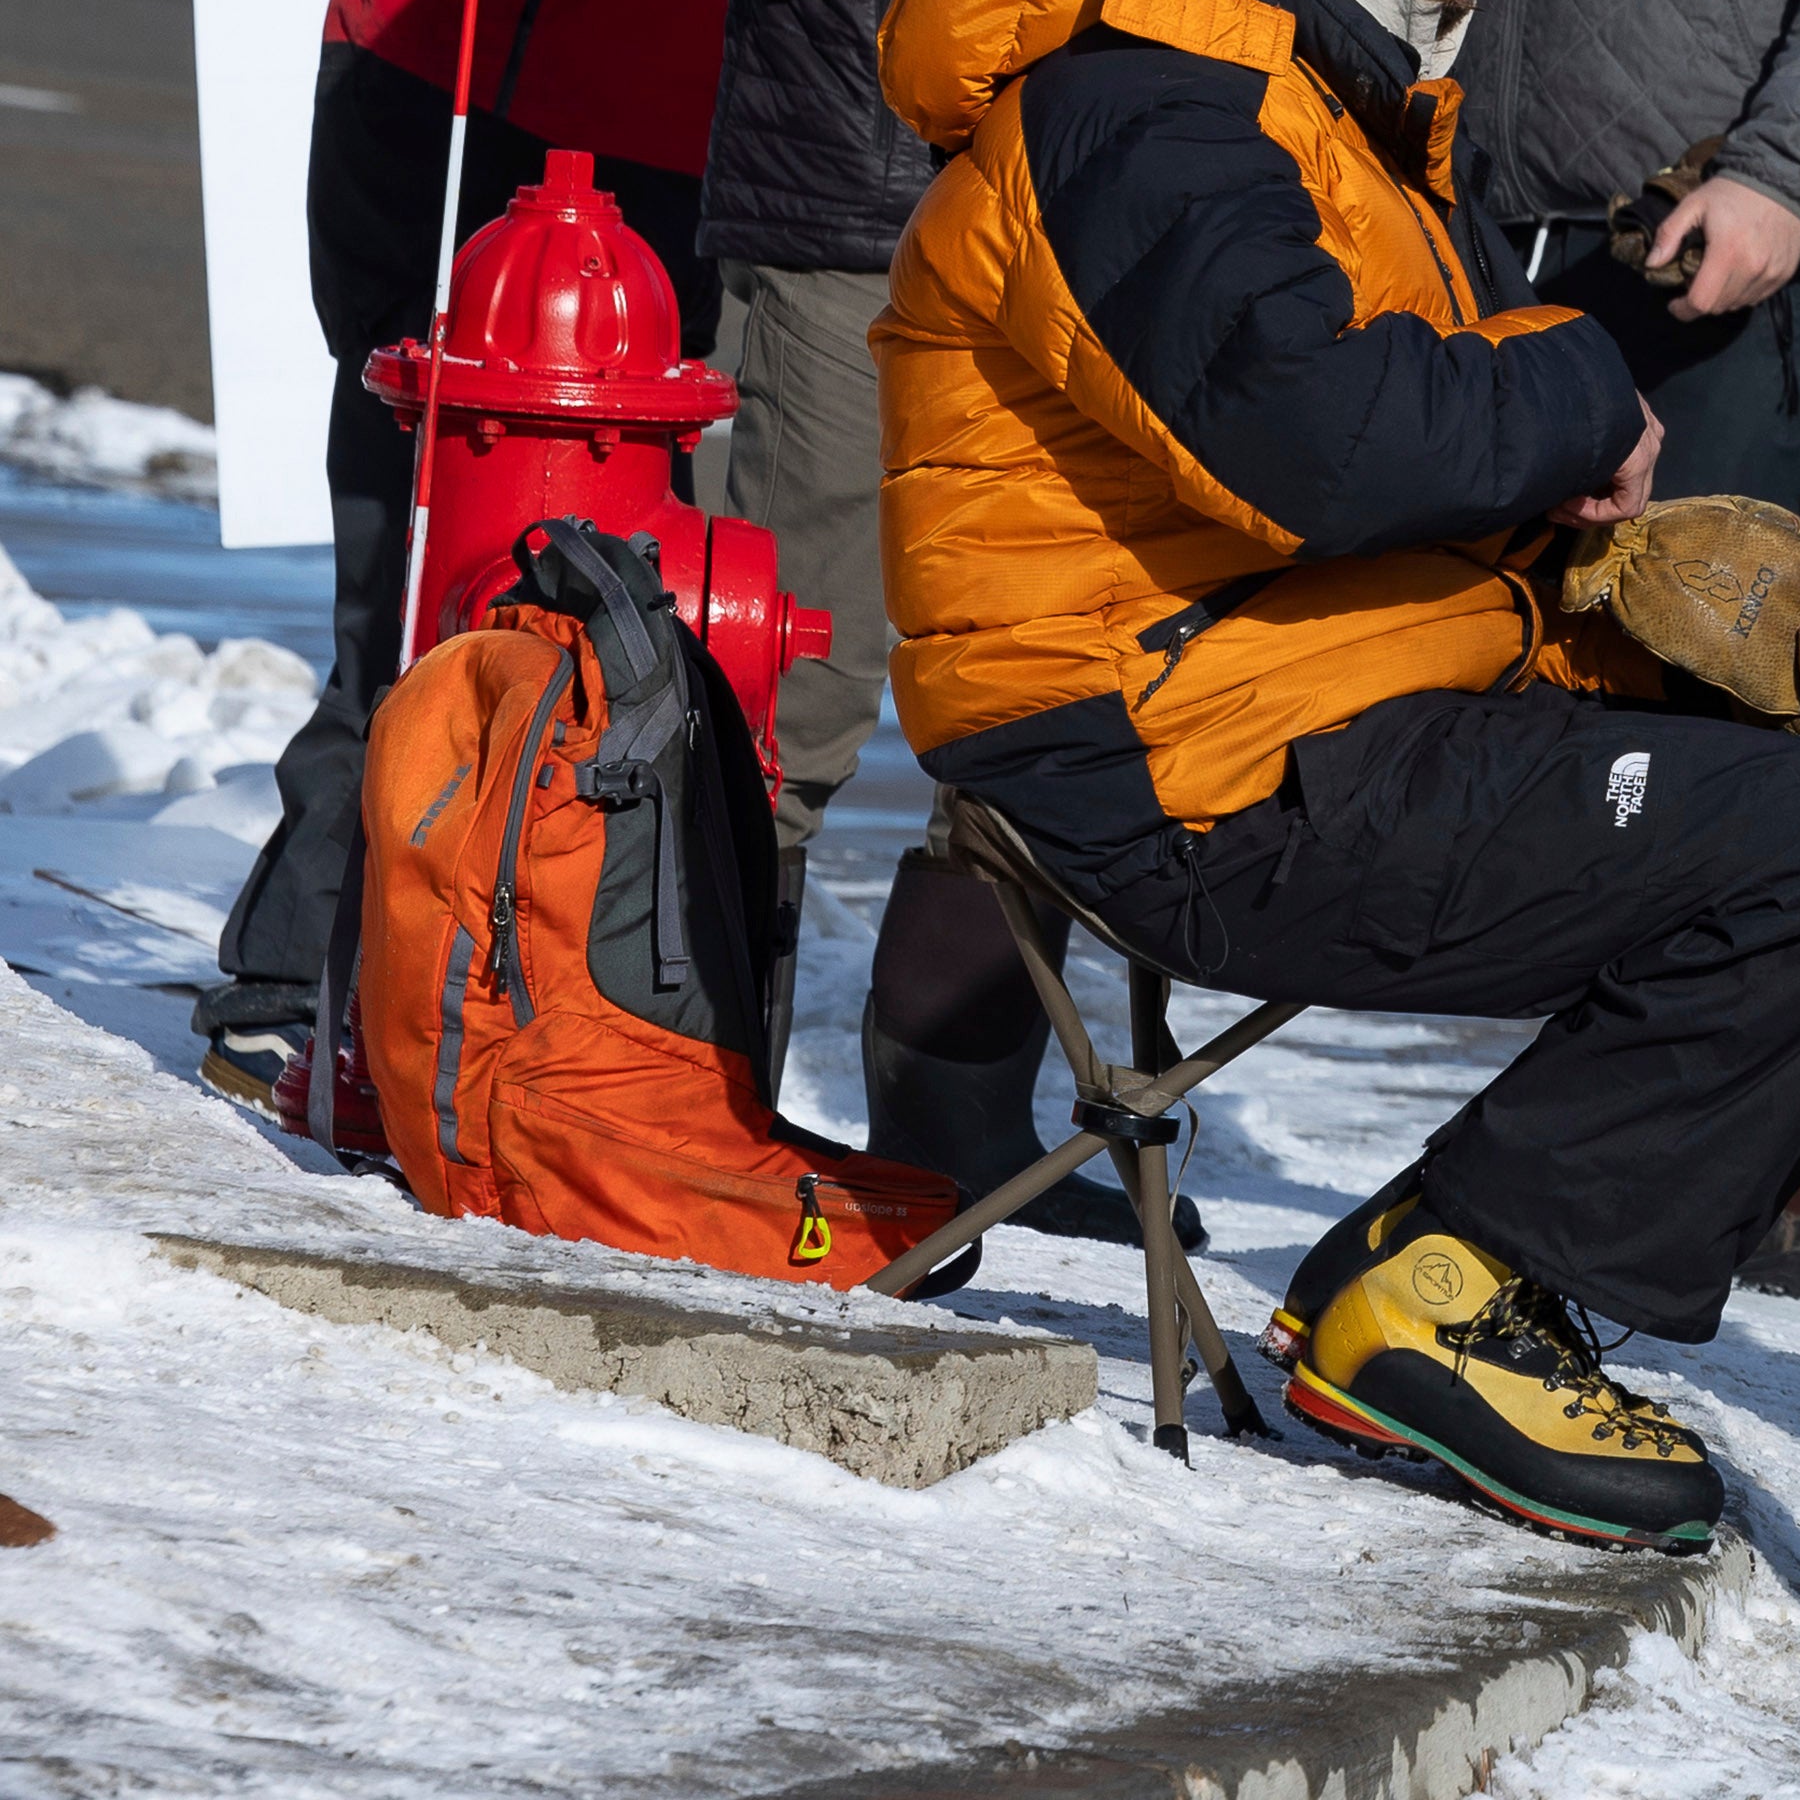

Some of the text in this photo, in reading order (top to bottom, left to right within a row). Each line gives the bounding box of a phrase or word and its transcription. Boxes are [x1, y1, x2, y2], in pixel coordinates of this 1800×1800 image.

[1732, 567, 1776, 639] KINCO
[409, 763, 472, 849] THULE
[1606, 772, 1622, 802] THE
[1614, 774, 1635, 828] NORTH
[1630, 775, 1647, 814] FACE
